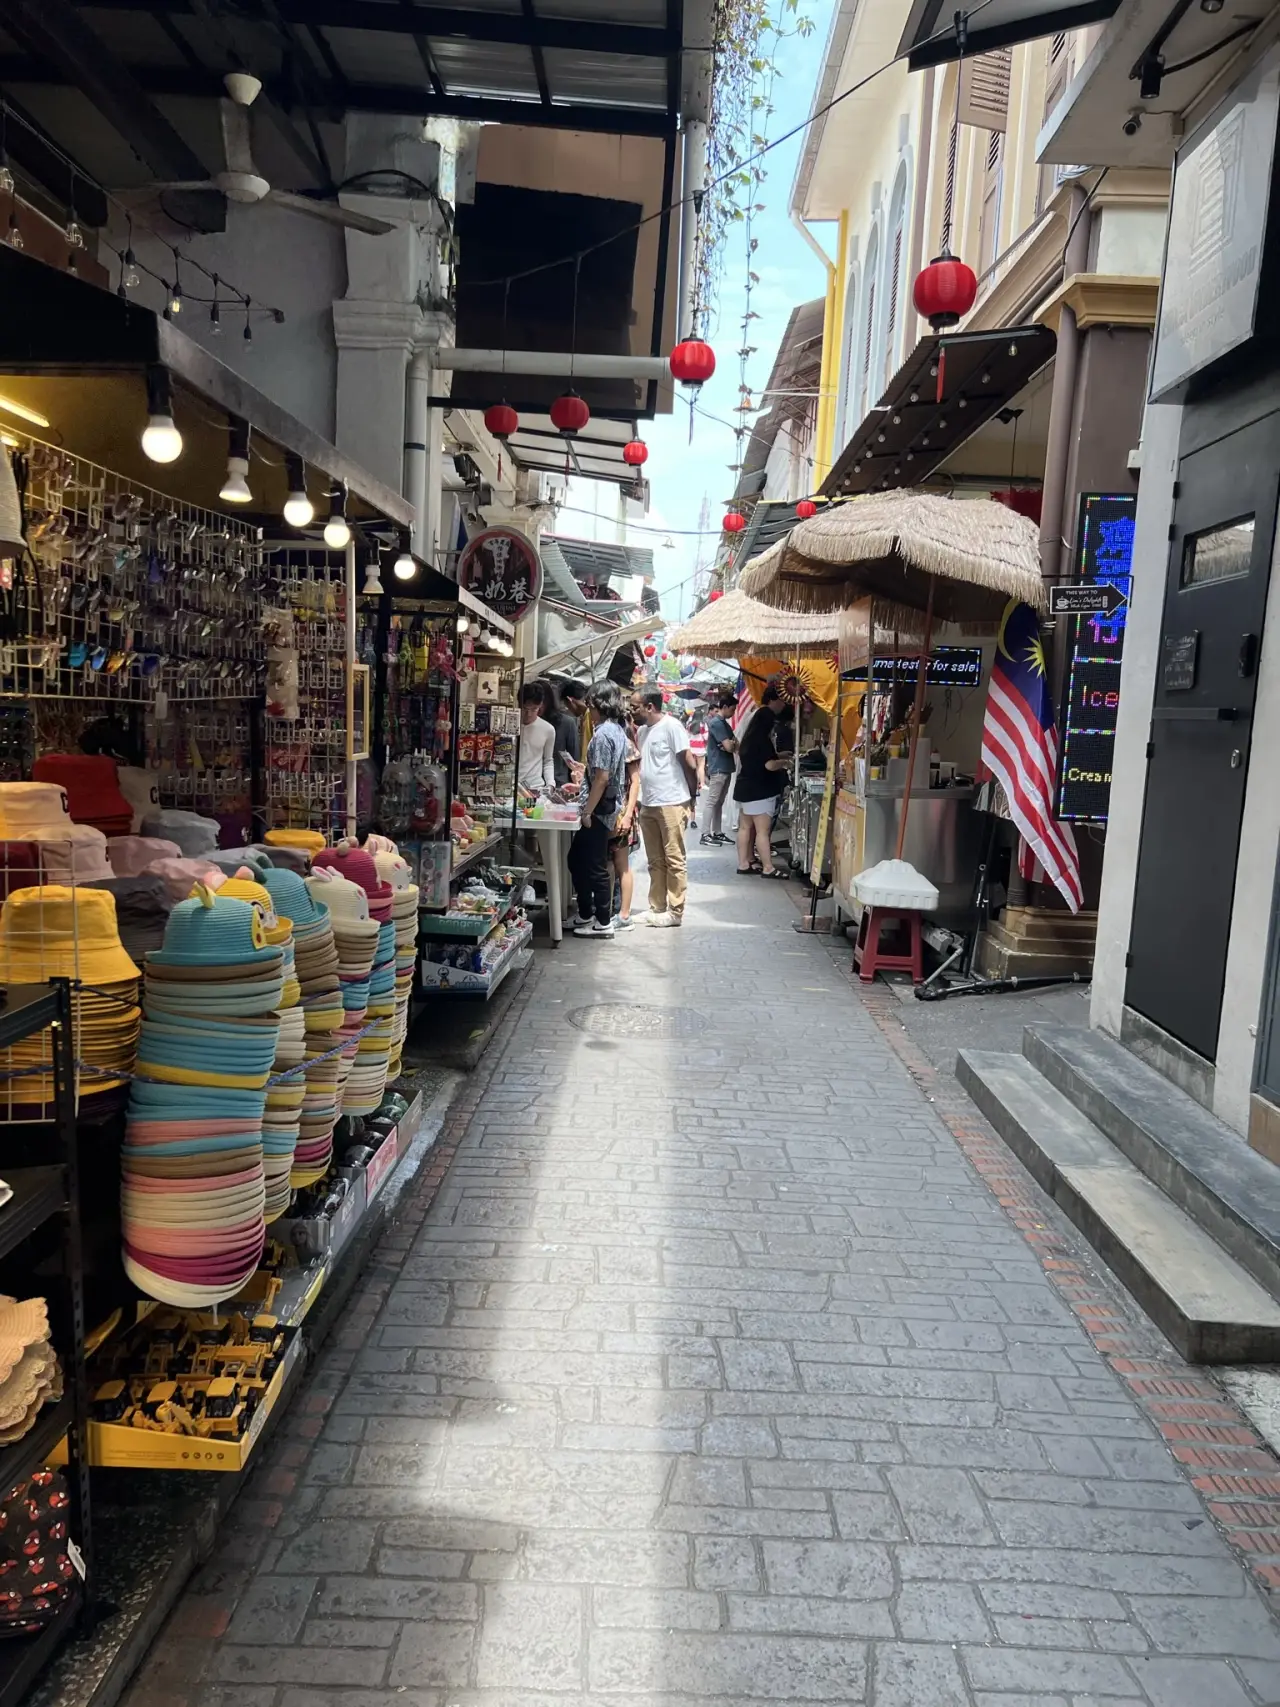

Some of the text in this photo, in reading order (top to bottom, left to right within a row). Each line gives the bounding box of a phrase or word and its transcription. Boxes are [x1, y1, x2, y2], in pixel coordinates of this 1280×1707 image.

[467, 576, 535, 604] 二奶巷
[932, 659, 949, 672] for
[950, 662, 977, 673] sale
[1082, 685, 1118, 707] Ice
[459, 740, 474, 749] UNO
[478, 740, 494, 749] UNO
